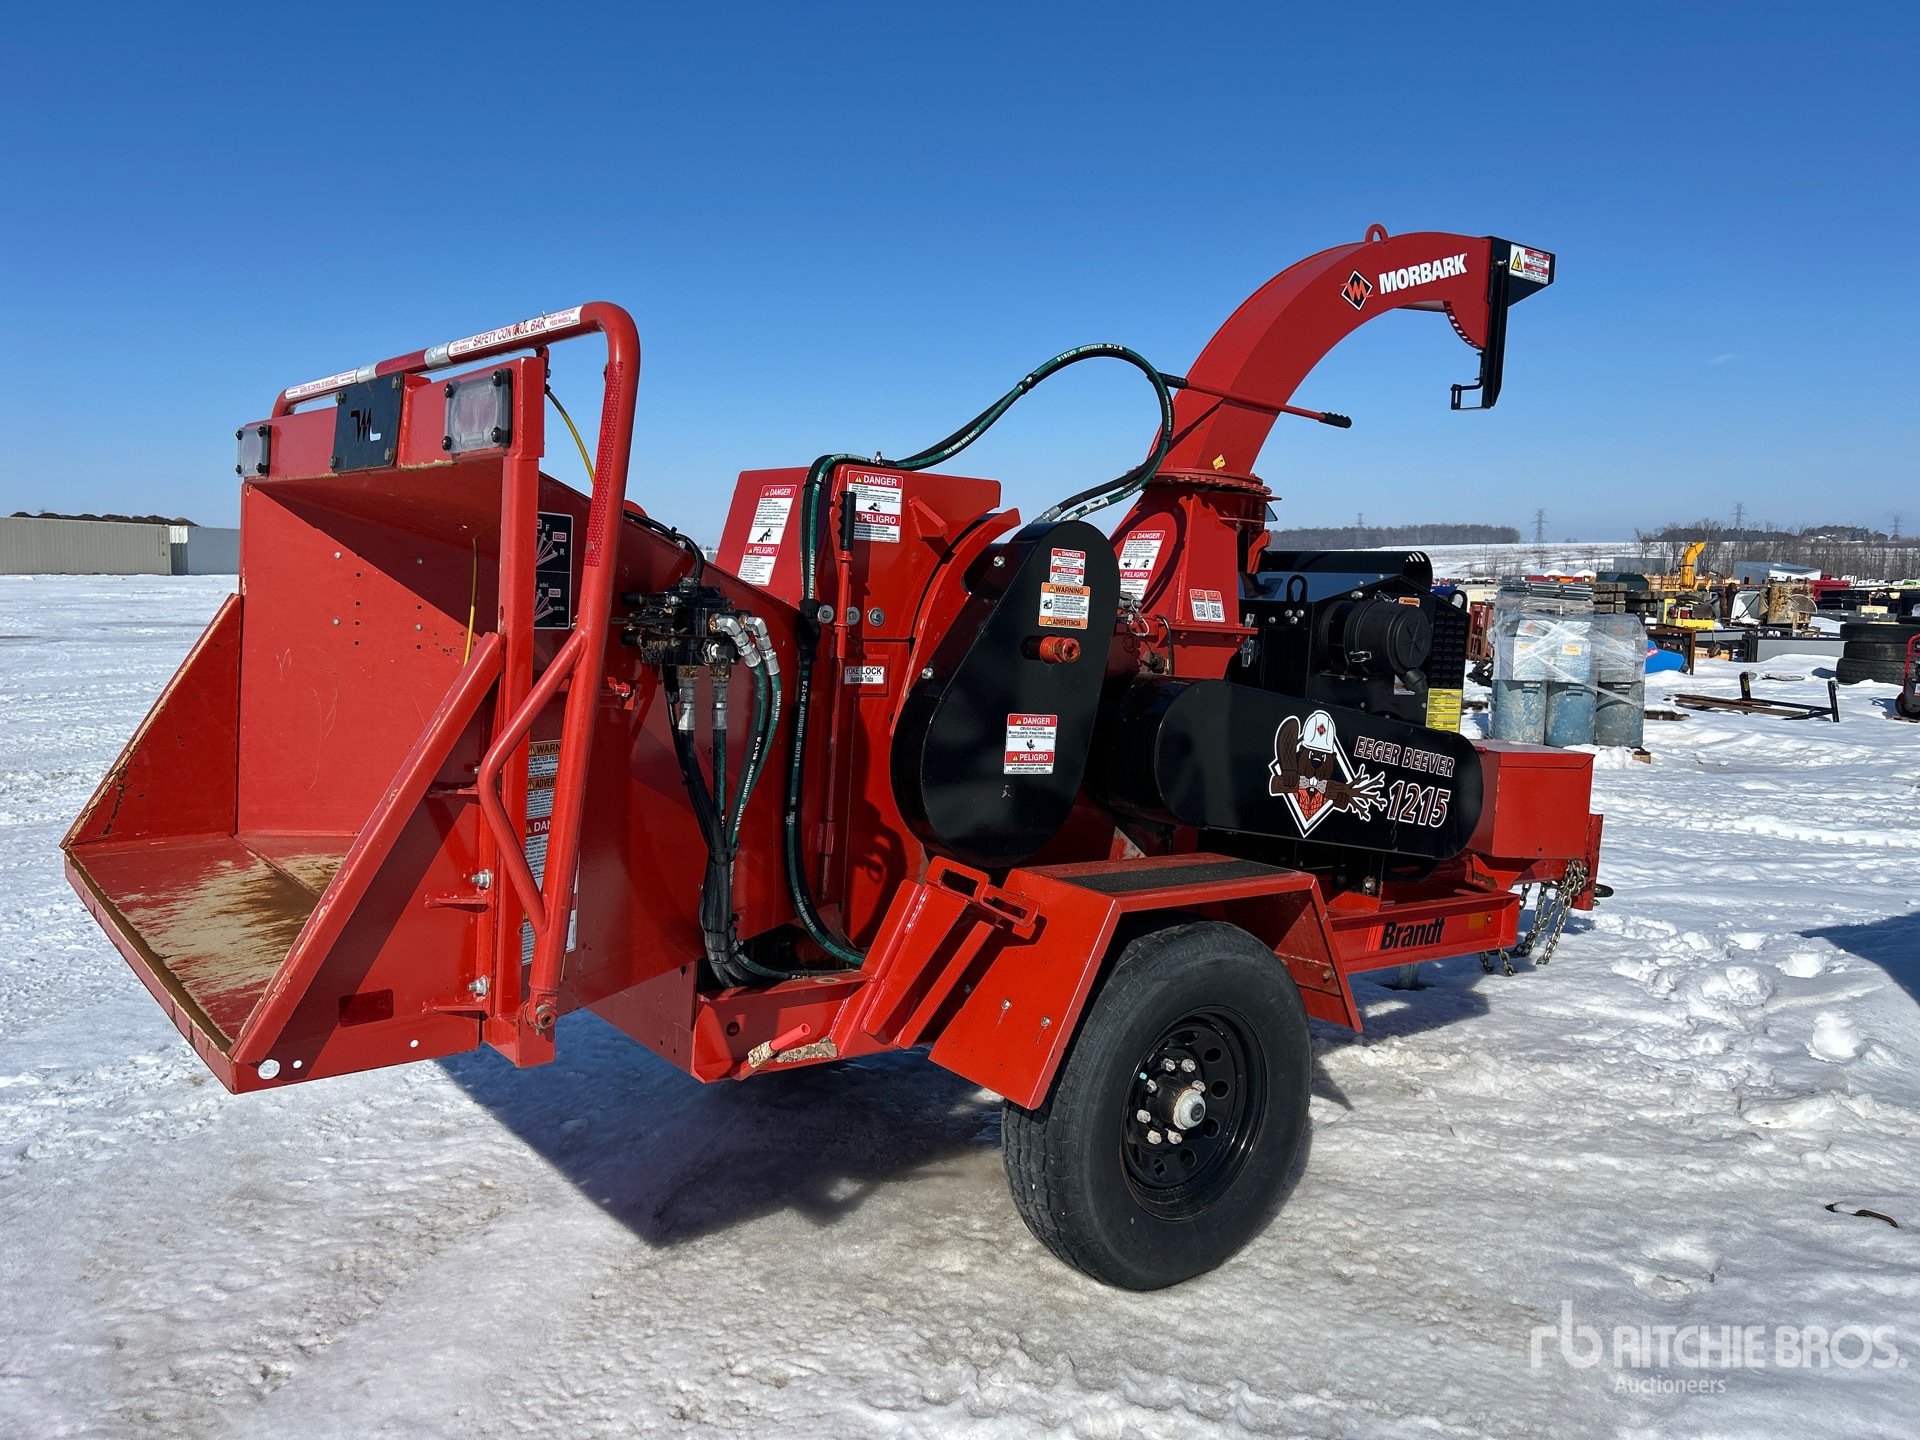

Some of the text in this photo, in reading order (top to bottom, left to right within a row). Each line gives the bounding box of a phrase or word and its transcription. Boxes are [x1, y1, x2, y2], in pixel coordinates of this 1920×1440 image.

[1379, 253, 1467, 294] MORBARK
[472, 332, 498, 346] SAFETY
[530, 319, 546, 331] BAR
[864, 475, 897, 486] DANGER
[770, 488, 791, 496] DANGER
[861, 513, 897, 524] PELIGRO
[559, 548, 565, 556] R
[753, 546, 775, 554] PELIGRO
[1055, 586, 1084, 595] WARNING
[1053, 618, 1081, 627] ADVERTENCIA
[846, 667, 882, 675] YOKE LOCK
[1022, 717, 1051, 725] DANGER
[1354, 736, 1455, 778] EEGER BEEVER
[1387, 780, 1451, 828] 1215
[1380, 917, 1445, 950] Brandt
